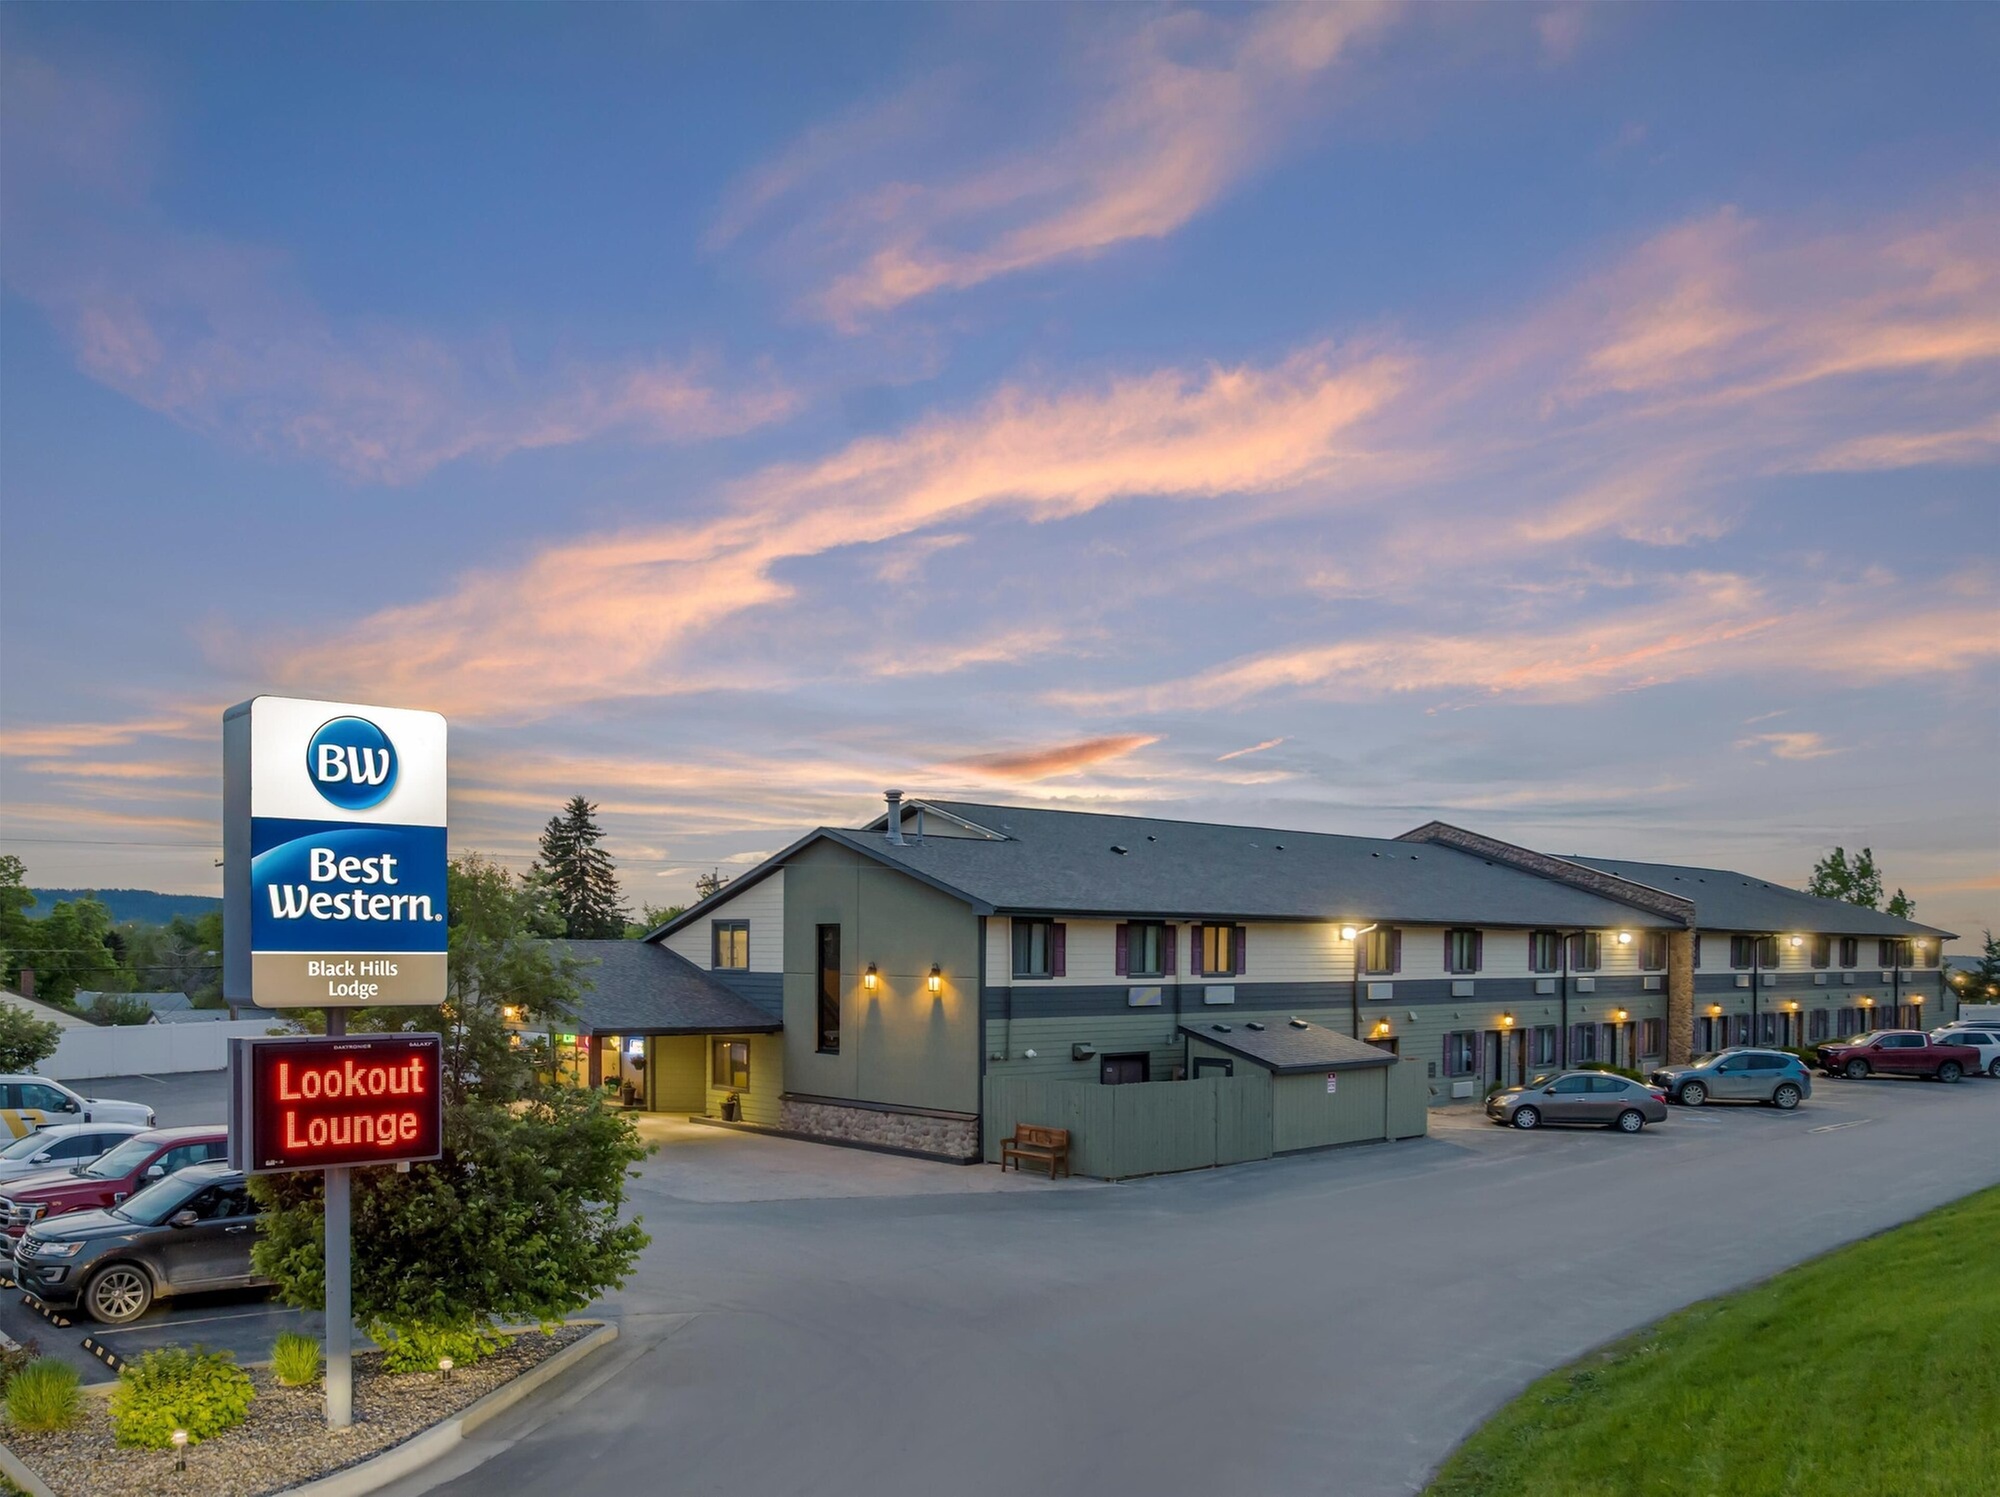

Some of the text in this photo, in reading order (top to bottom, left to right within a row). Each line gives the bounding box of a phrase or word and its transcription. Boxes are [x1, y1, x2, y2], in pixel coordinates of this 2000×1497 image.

[318, 744, 390, 786] BW
[310, 848, 398, 885] Best
[308, 960, 398, 977] Black Hills
[328, 980, 379, 998] Lodge
[279, 1058, 424, 1100] Lookout
[286, 1111, 418, 1148] Lounge
